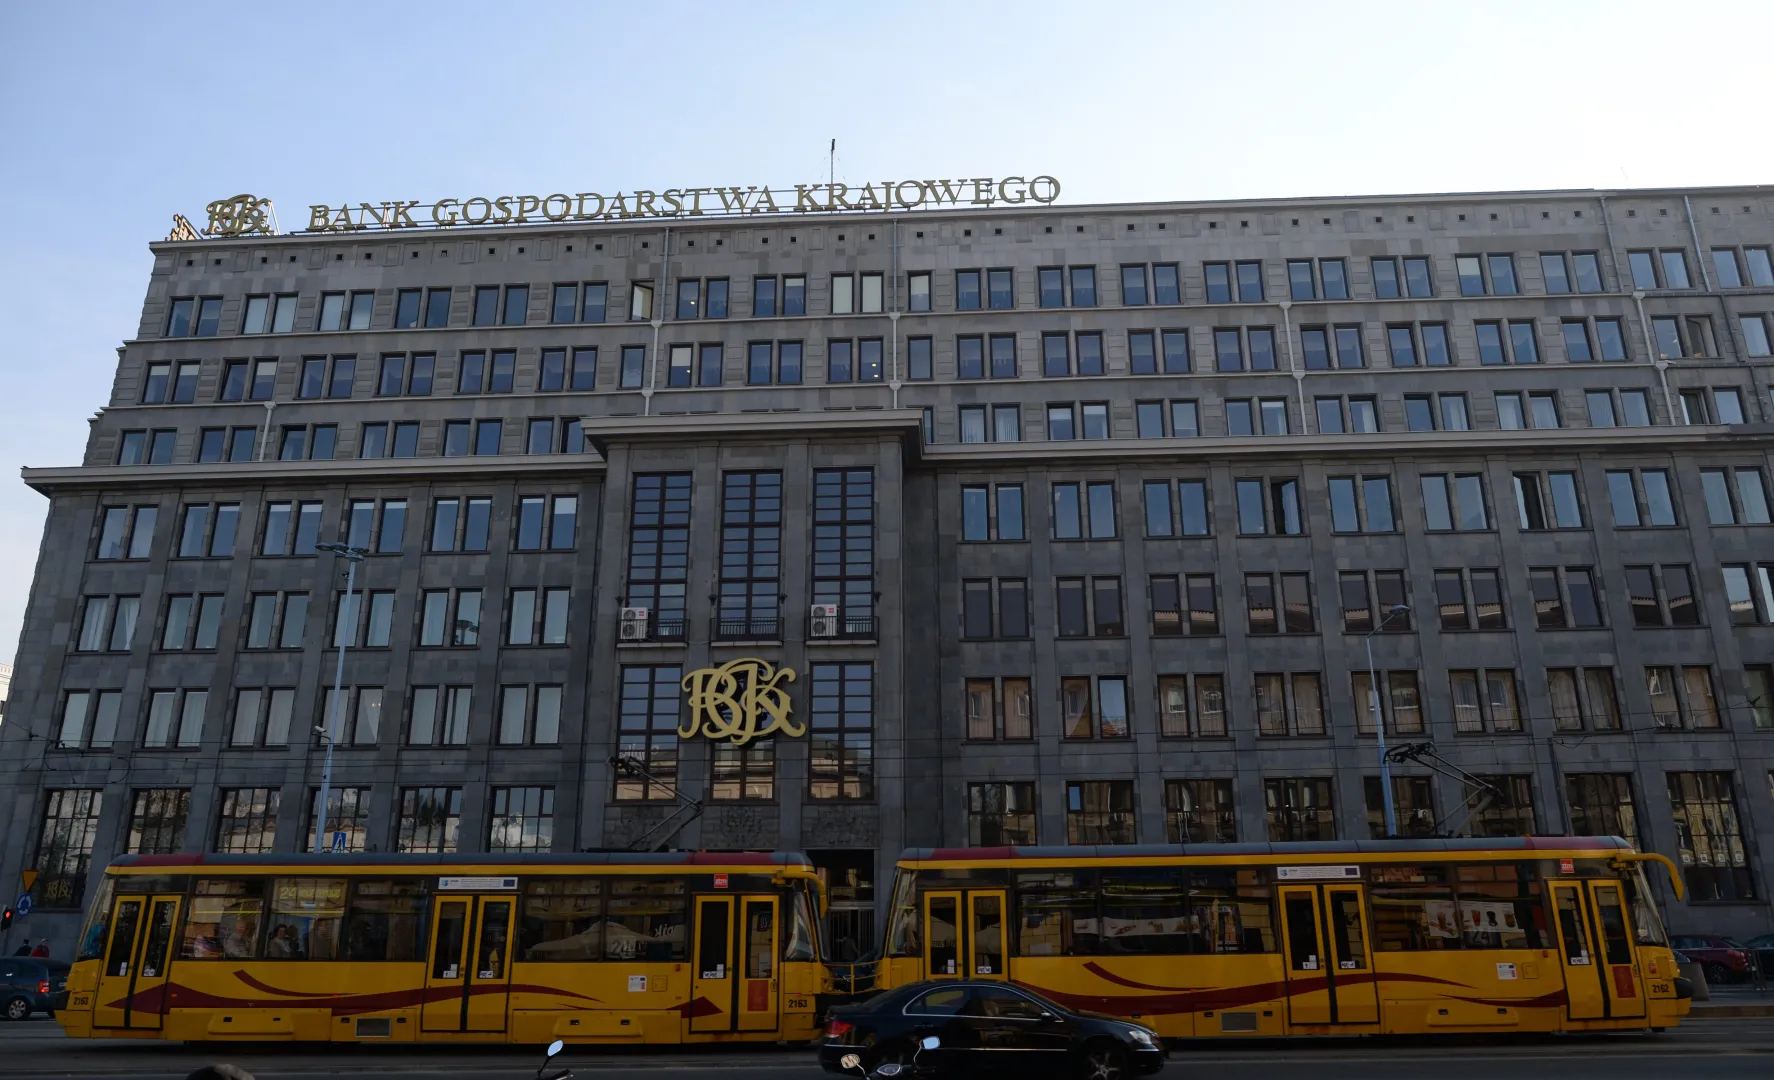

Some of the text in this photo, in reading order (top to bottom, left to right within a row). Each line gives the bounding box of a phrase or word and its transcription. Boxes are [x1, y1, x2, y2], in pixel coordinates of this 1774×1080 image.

[305, 175, 1061, 232] BANK GOSPODARSTWA KRAJOWEGO
[1651, 983, 1671, 994] 2162
[787, 999, 808, 1009] 2163
